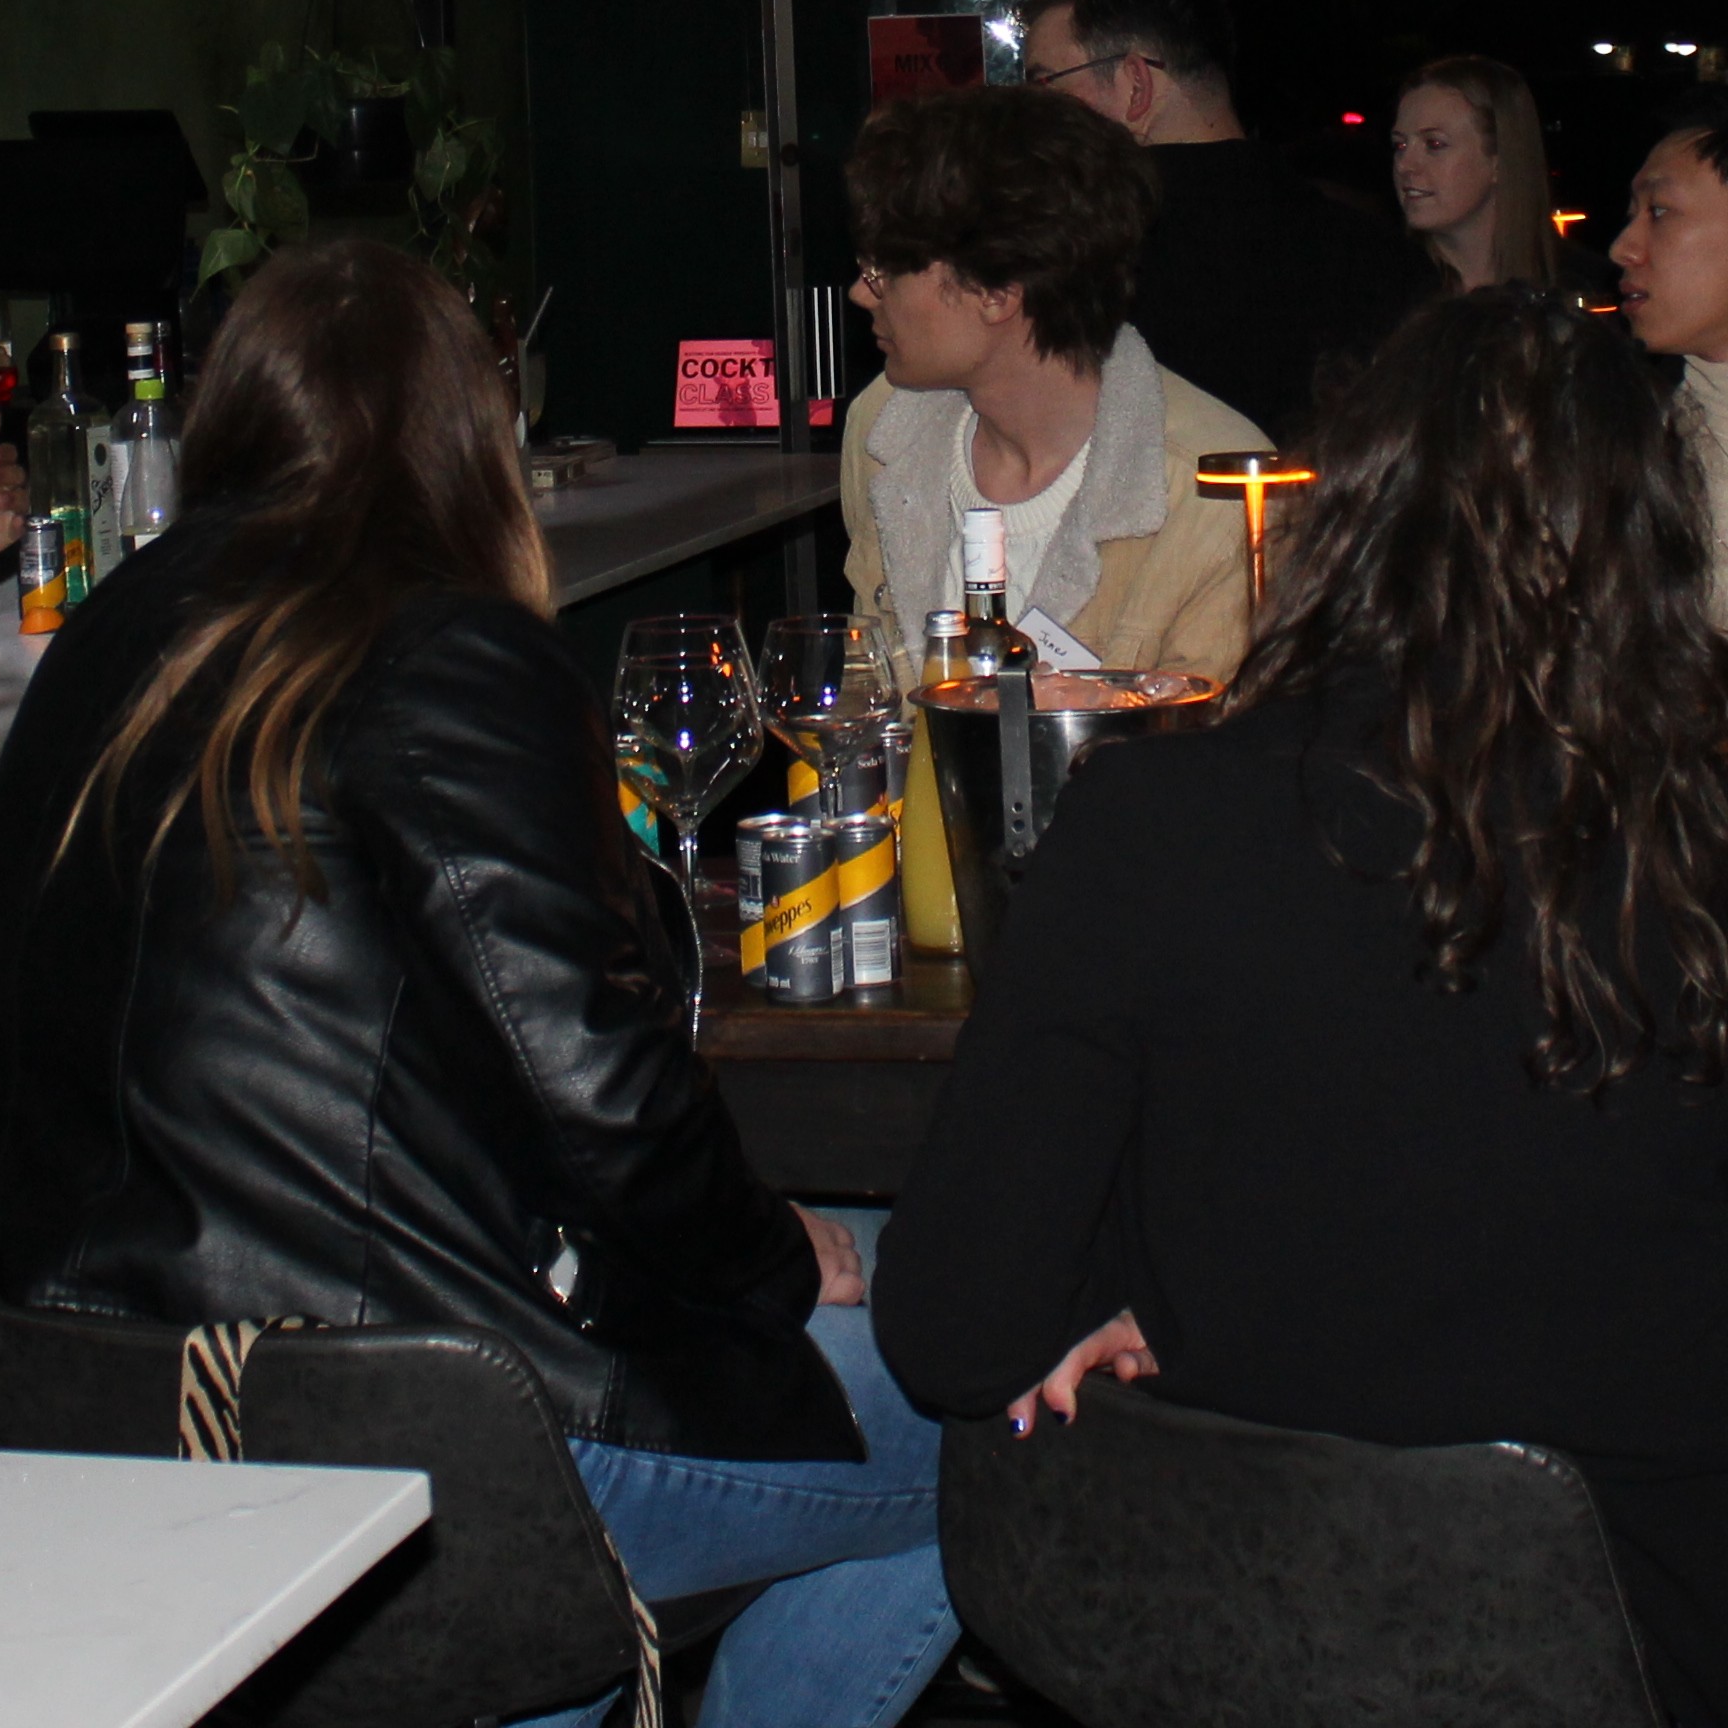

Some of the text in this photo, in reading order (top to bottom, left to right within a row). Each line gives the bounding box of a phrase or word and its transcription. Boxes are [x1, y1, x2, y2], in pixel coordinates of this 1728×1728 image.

[894, 54, 932, 73] MIX
[681, 357, 775, 379] COCKT
[679, 382, 770, 405] CLASS
[857, 756, 878, 768] Soda
[771, 850, 801, 865] Water
